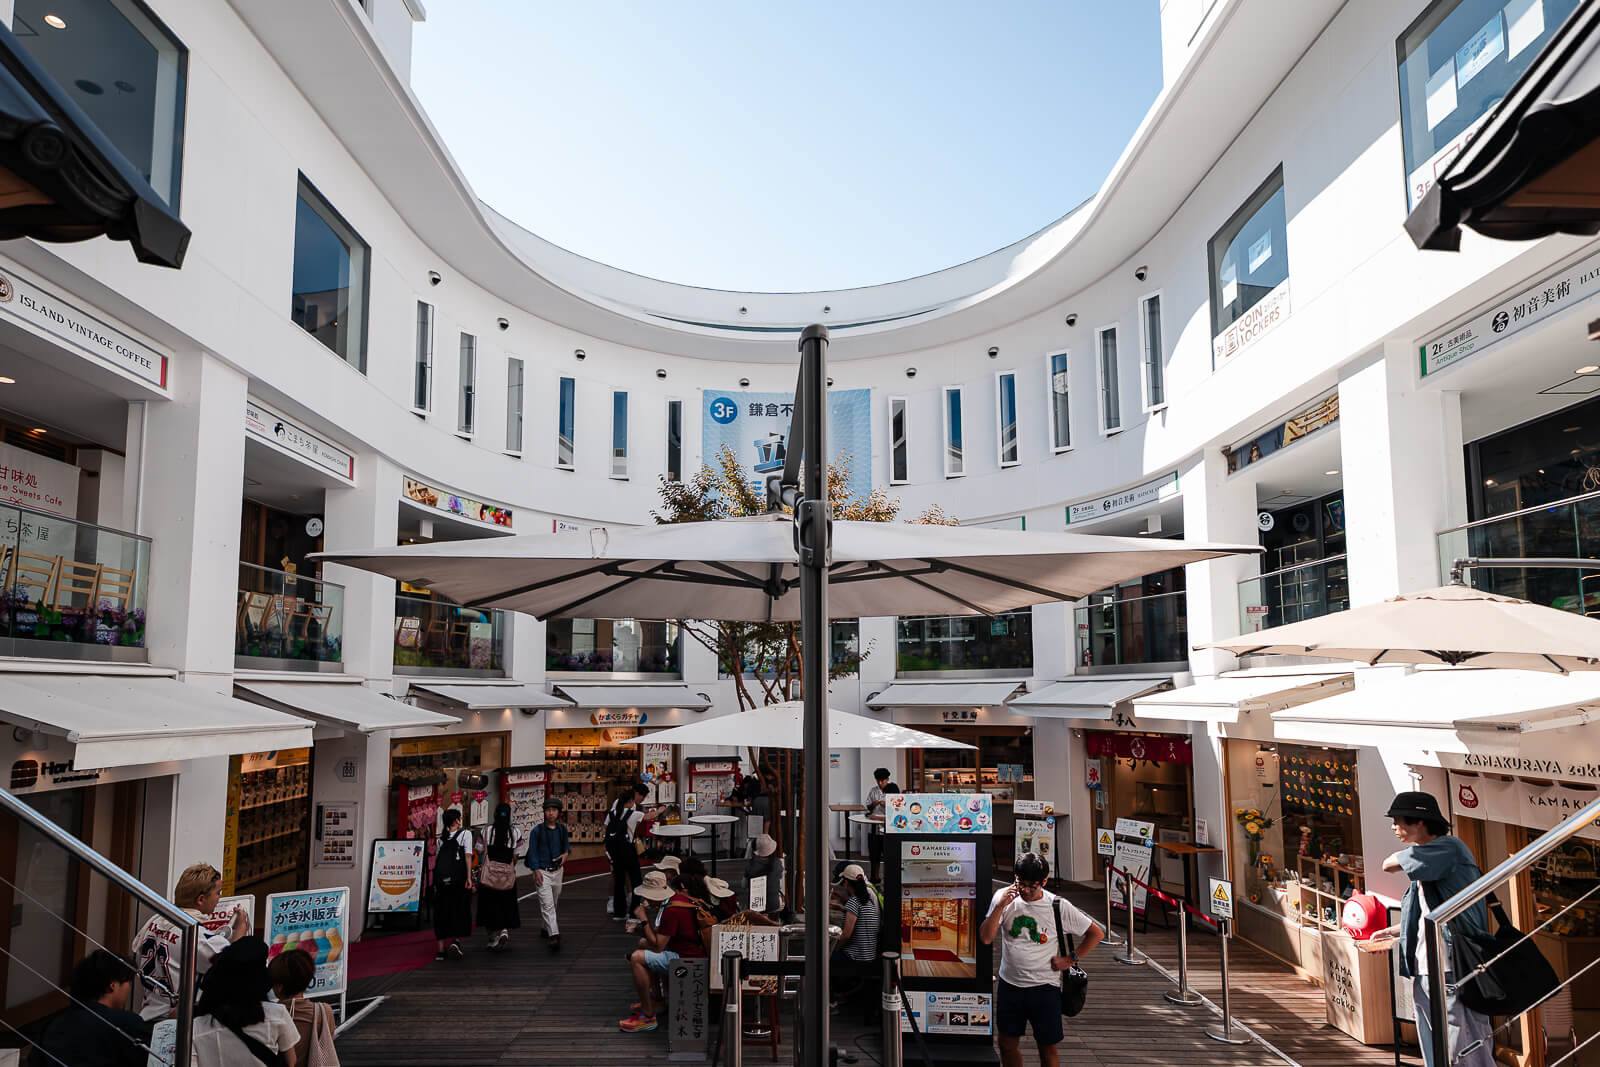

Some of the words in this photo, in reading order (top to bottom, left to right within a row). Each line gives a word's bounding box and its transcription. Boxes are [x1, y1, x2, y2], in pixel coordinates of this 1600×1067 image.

[1416, 181, 1430, 200] 3F
[1513, 279, 1571, 322] 初音美術
[1239, 305, 1262, 332] COIN
[1241, 306, 1279, 346] LOCKERS
[19, 294, 64, 324] ISLAND
[67, 322, 113, 351] VINTAGE
[116, 344, 153, 371] COFFEE
[1432, 343, 1443, 357] 2F
[1447, 330, 1472, 348] 古美術品
[1436, 351, 1457, 367] Antique
[1459, 341, 1474, 355] Shop
[714, 402, 734, 418] 3F
[288, 432, 318, 454] こまち茶屋
[0, 464, 38, 489] 甘味処
[12, 485, 41, 501] Sweets
[45, 494, 63, 507] Cafe
[1112, 494, 1135, 508] 初音美術
[599, 713, 639, 721] かまくらガチャ
[1464, 754, 1562, 775] KAMAKURAYA
[1568, 763, 1600, 778] zak
[275, 907, 340, 925] かき氷販売
[1330, 960, 1352, 977] KAMA
[1330, 971, 1353, 988] KURA
[1338, 984, 1347, 997] YA
